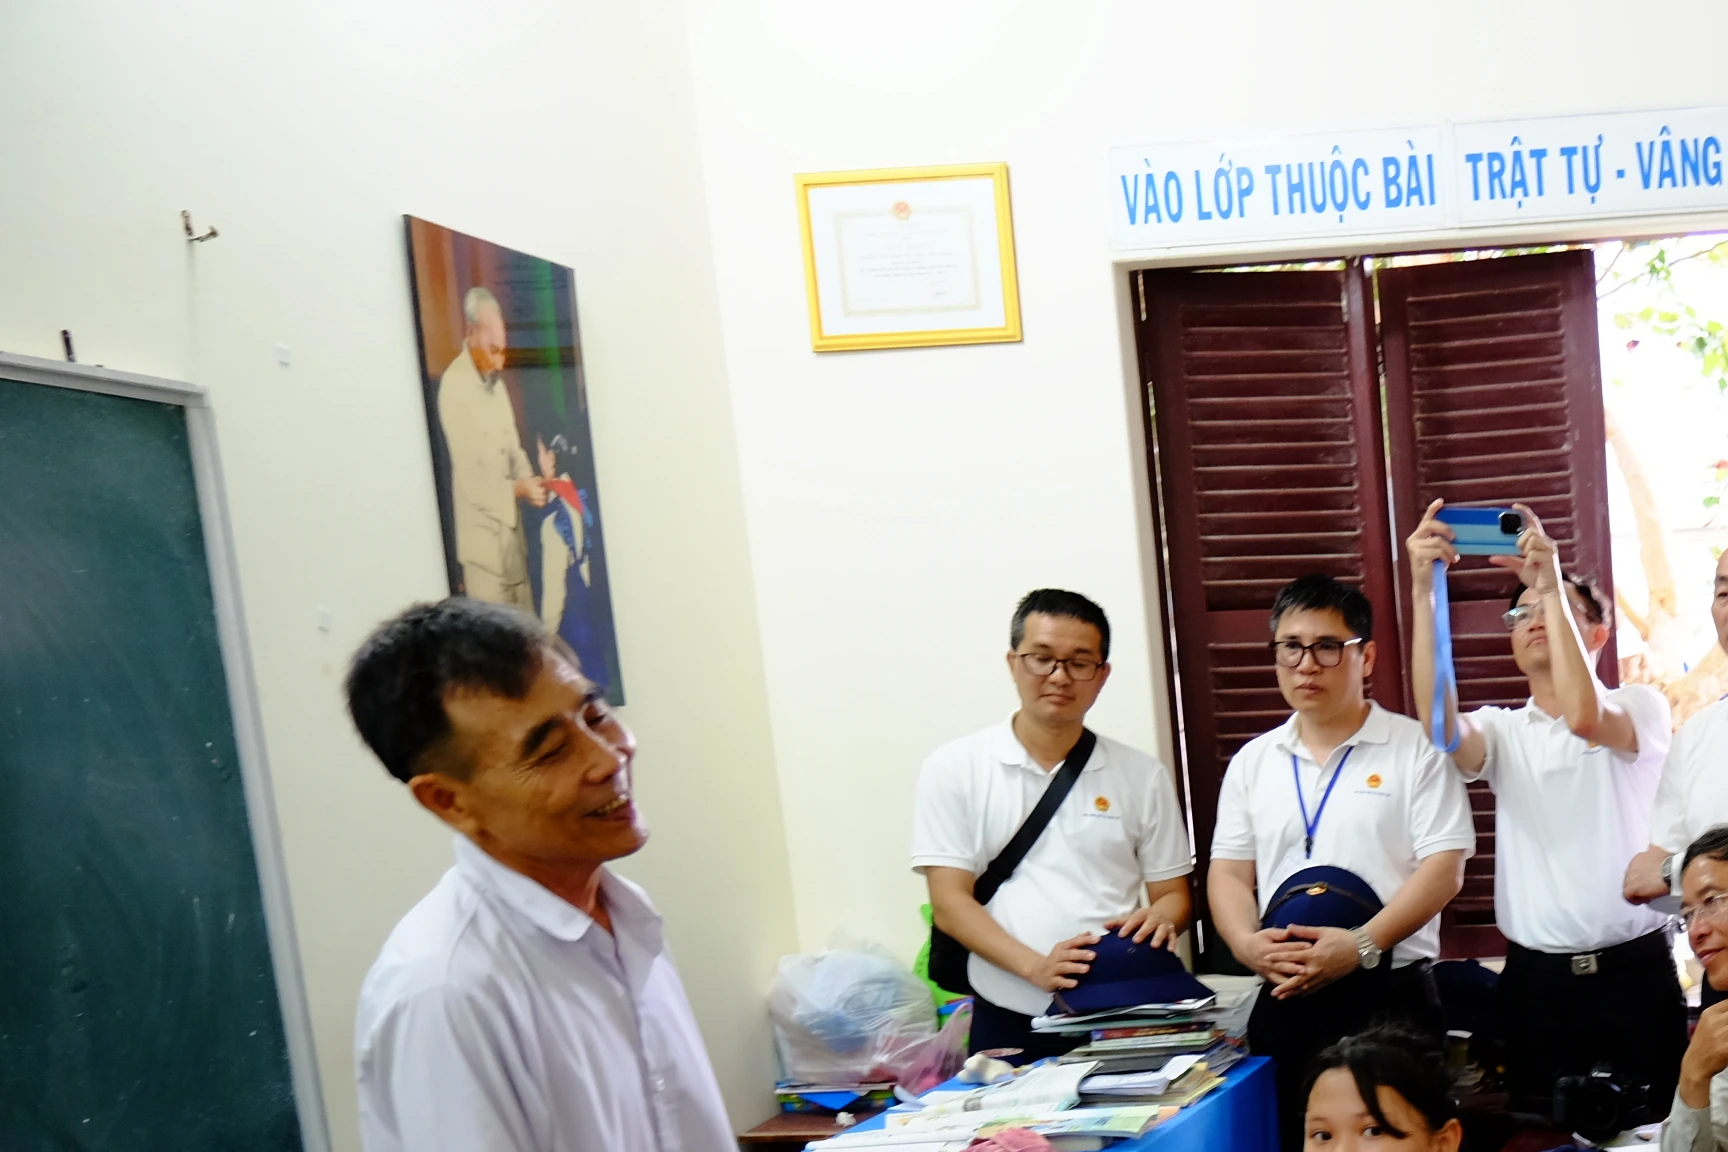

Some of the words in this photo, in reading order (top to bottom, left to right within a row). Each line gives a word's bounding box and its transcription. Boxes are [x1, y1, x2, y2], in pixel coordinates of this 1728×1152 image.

[1120, 158, 1184, 226] VÀO
[1194, 152, 1254, 220] LỚP
[1264, 144, 1371, 223] THUỘC
[1382, 139, 1437, 208] BÀI
[1465, 135, 1548, 209] TRẬT
[1560, 133, 1604, 205] TỰ
[1635, 125, 1722, 190] VÂNG
